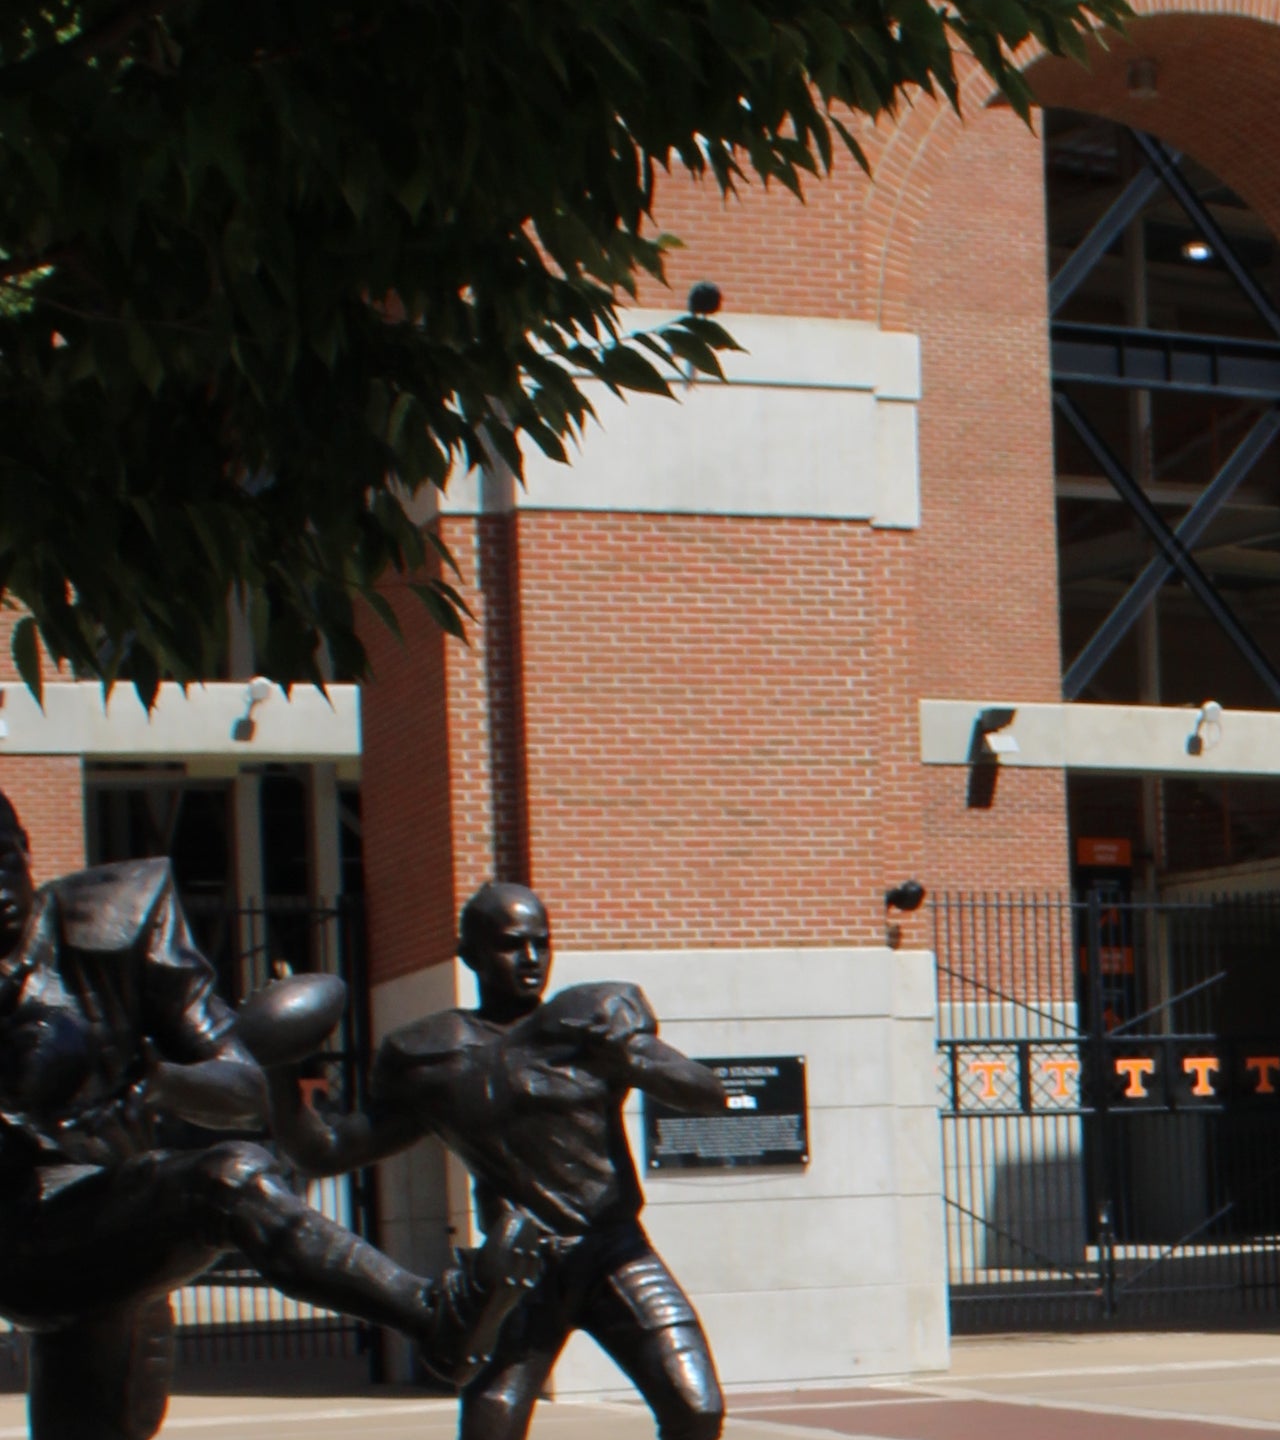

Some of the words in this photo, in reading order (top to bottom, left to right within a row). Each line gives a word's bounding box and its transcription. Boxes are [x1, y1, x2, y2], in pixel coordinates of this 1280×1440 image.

[970, 1062, 1007, 1097] T
[1042, 1061, 1079, 1096] T
[1116, 1058, 1153, 1097] T
[1183, 1057, 1219, 1096] T
